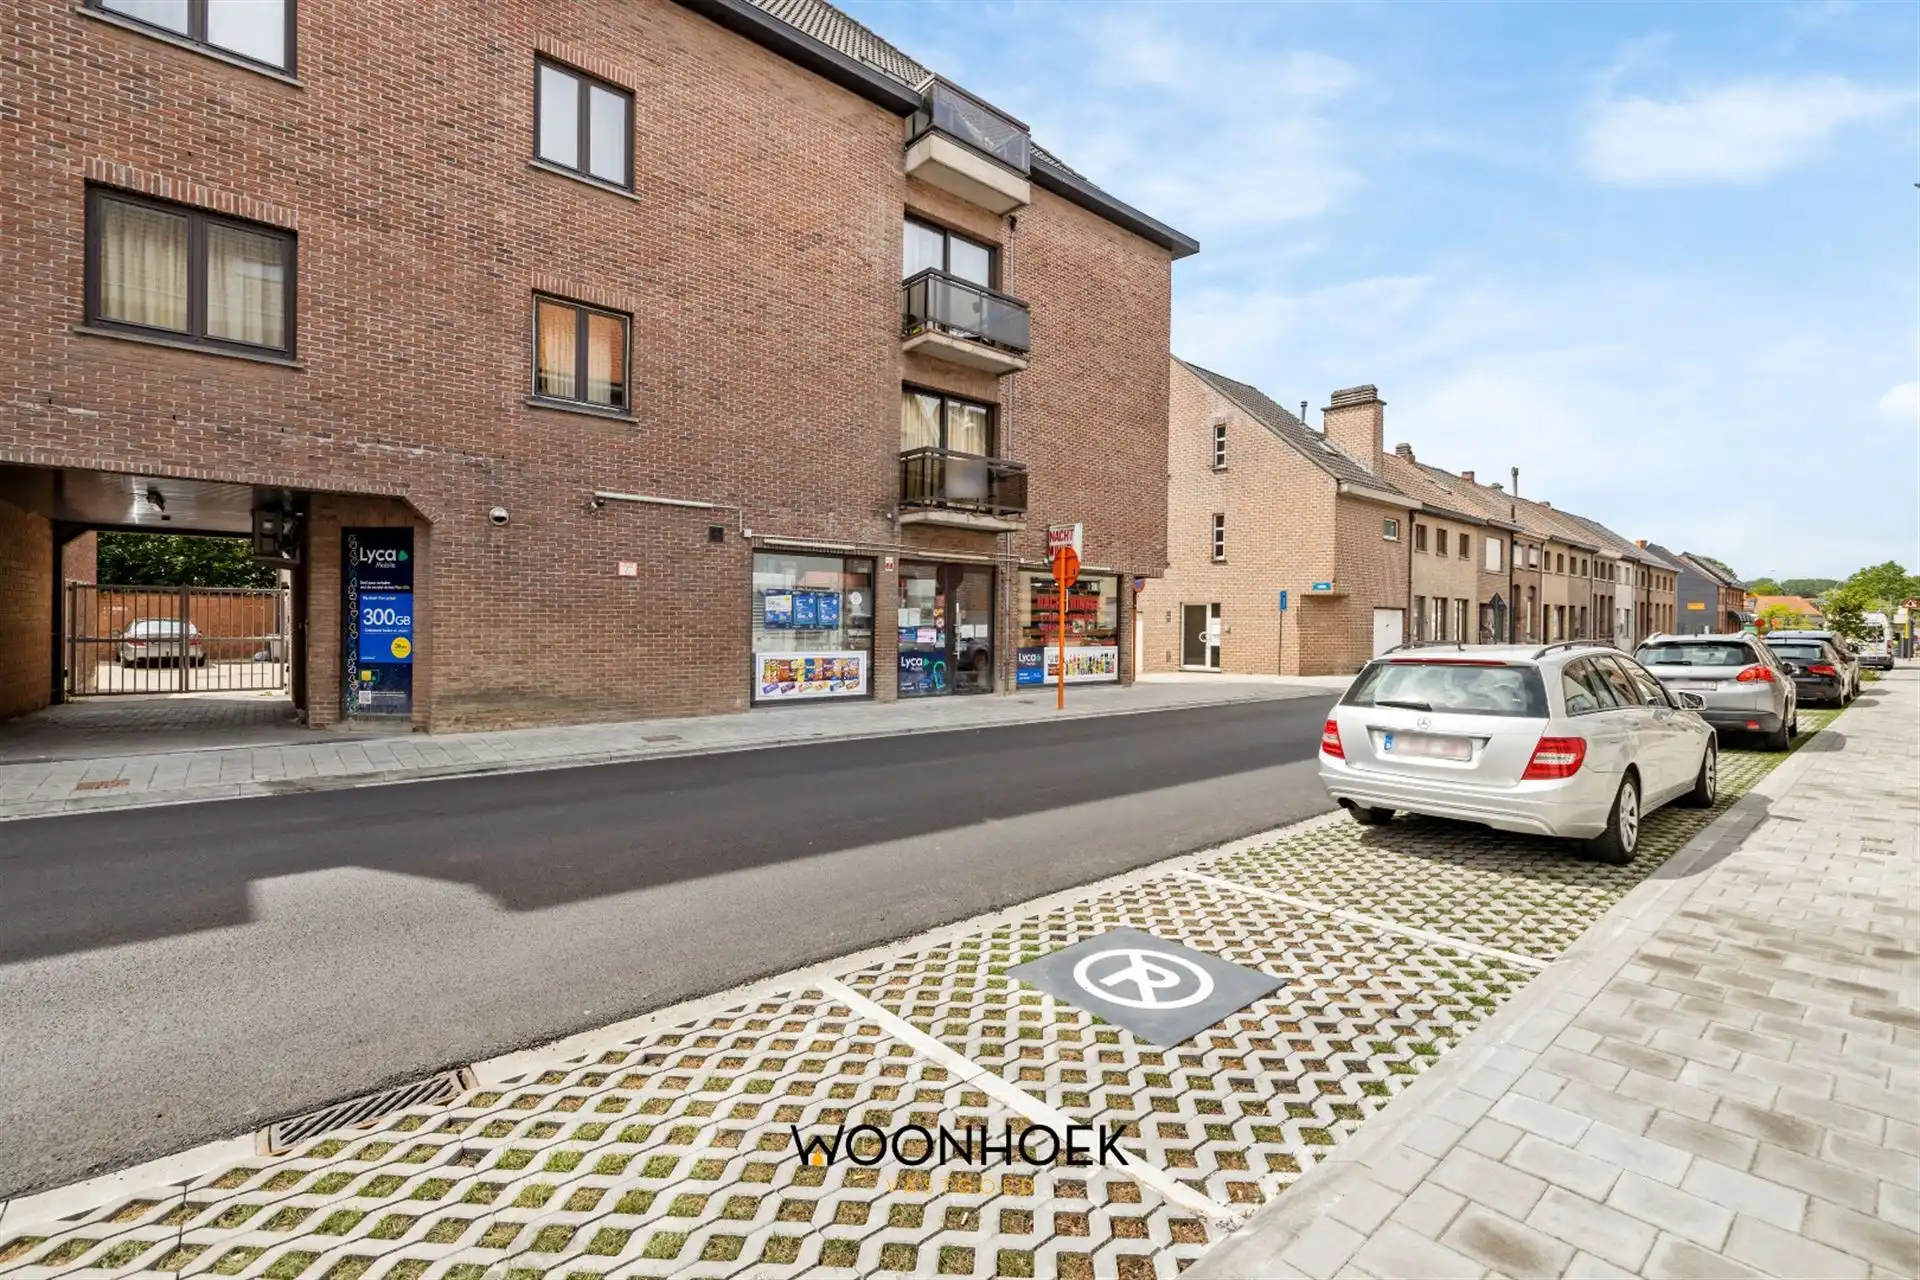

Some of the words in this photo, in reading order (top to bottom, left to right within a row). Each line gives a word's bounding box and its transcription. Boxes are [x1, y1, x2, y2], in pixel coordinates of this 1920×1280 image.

[1049, 530, 1073, 542] NACHT
[360, 547, 396, 564] Lyca
[901, 656, 923, 669] Lyca
[1018, 652, 1037, 664] Lyca
